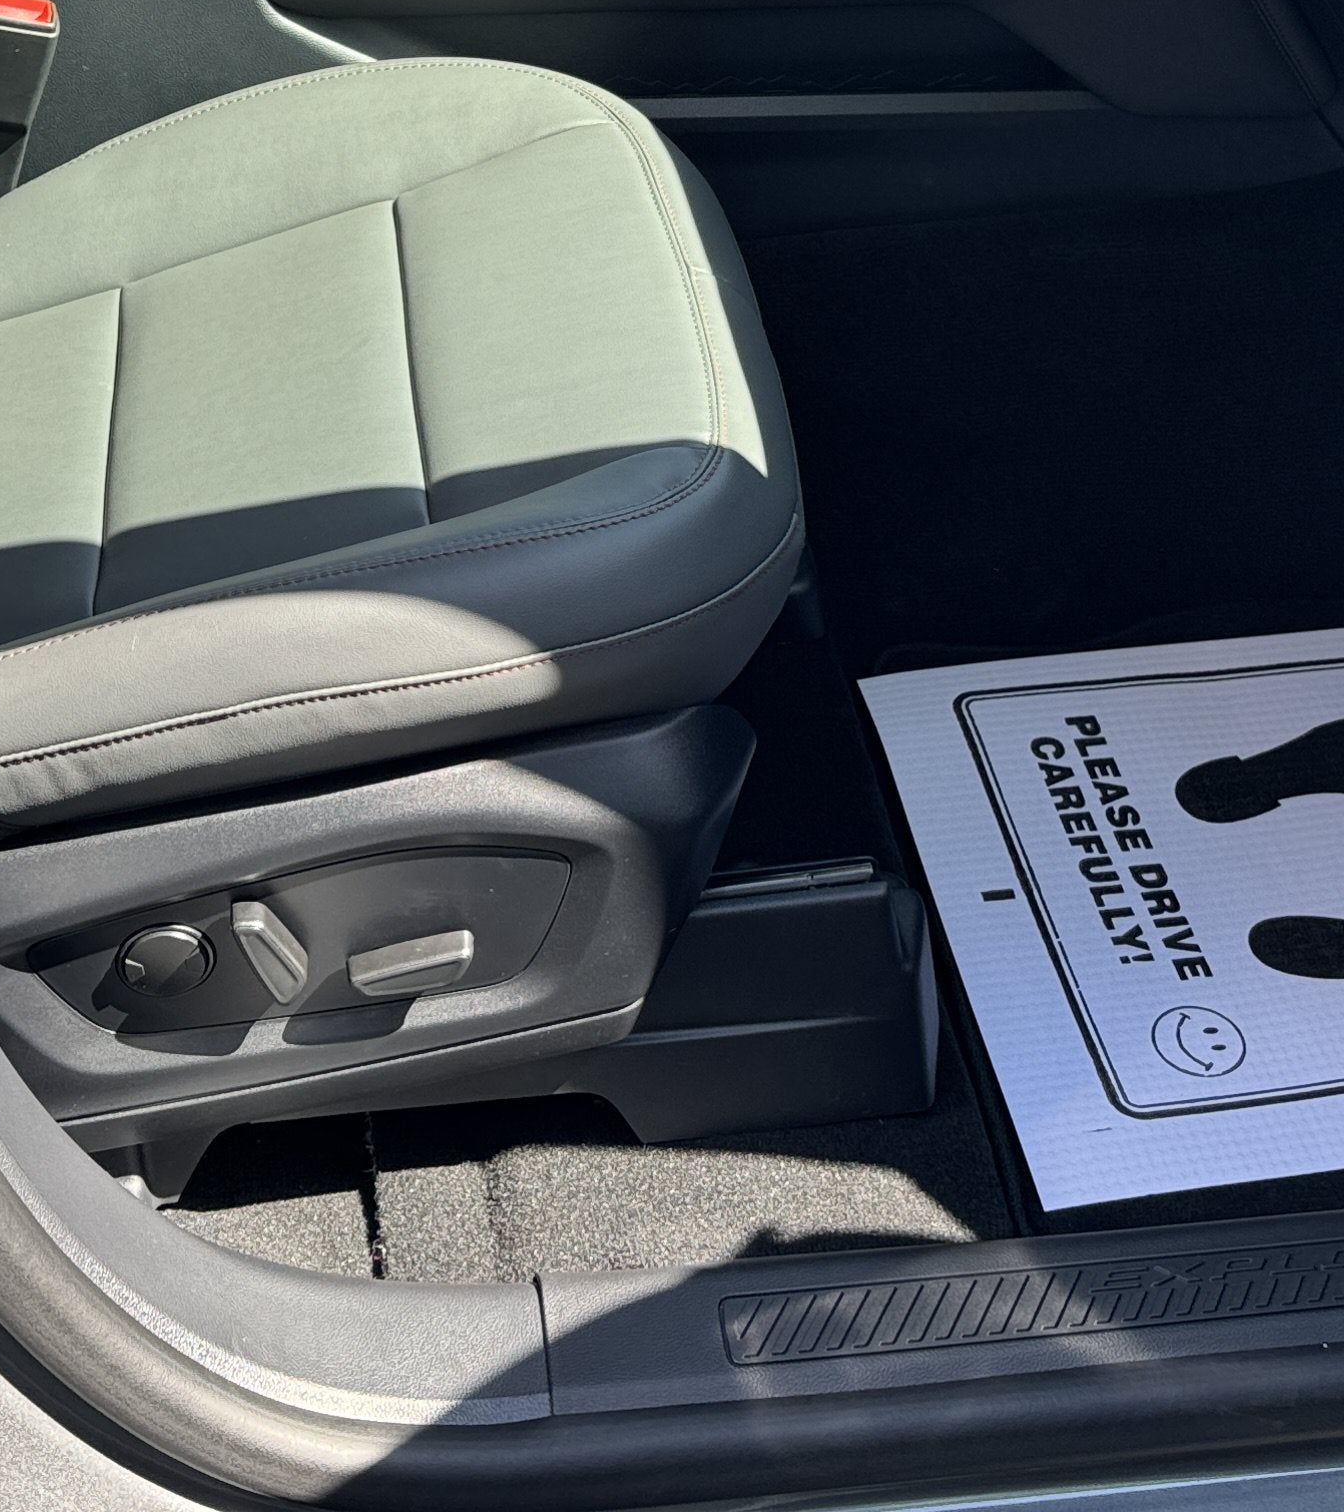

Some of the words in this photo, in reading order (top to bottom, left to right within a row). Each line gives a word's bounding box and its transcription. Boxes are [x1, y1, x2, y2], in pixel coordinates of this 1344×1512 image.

[1030, 737, 1156, 965] CAREFULLY!
[1064, 715, 1154, 852] PLEASE
[1128, 863, 1214, 981] DRIVE
